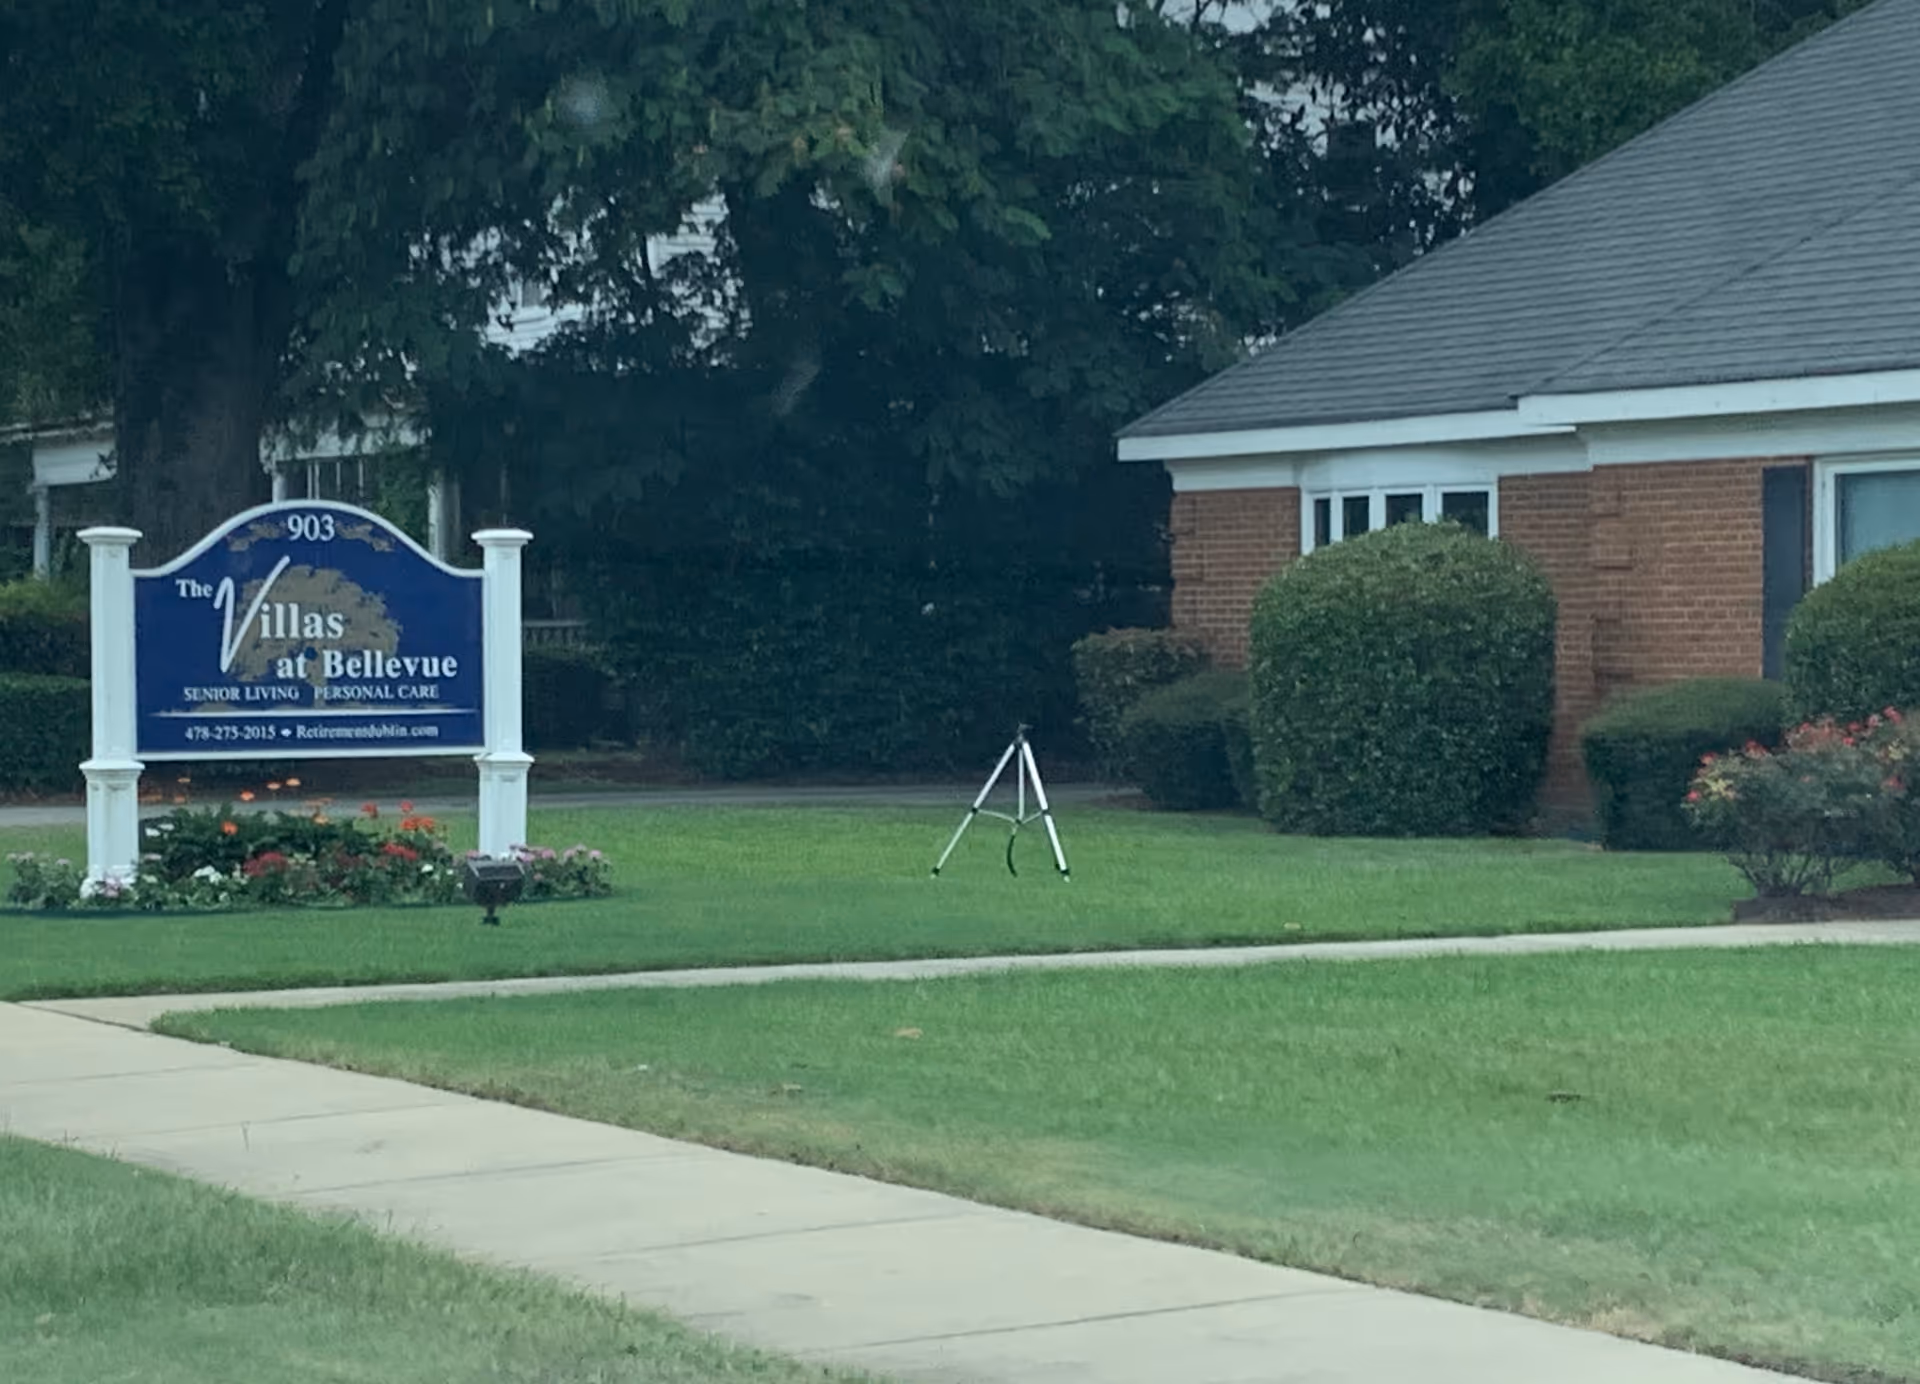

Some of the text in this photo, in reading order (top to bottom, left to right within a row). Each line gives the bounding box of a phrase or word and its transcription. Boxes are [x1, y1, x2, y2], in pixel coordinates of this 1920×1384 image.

[287, 514, 336, 541] 903
[176, 555, 344, 673] The Villas
[276, 650, 458, 678] at Bellevue
[184, 686, 299, 701] SENIOR LIVING
[314, 684, 440, 700] PERSONAL CARE
[185, 724, 276, 740] 478-275-2015
